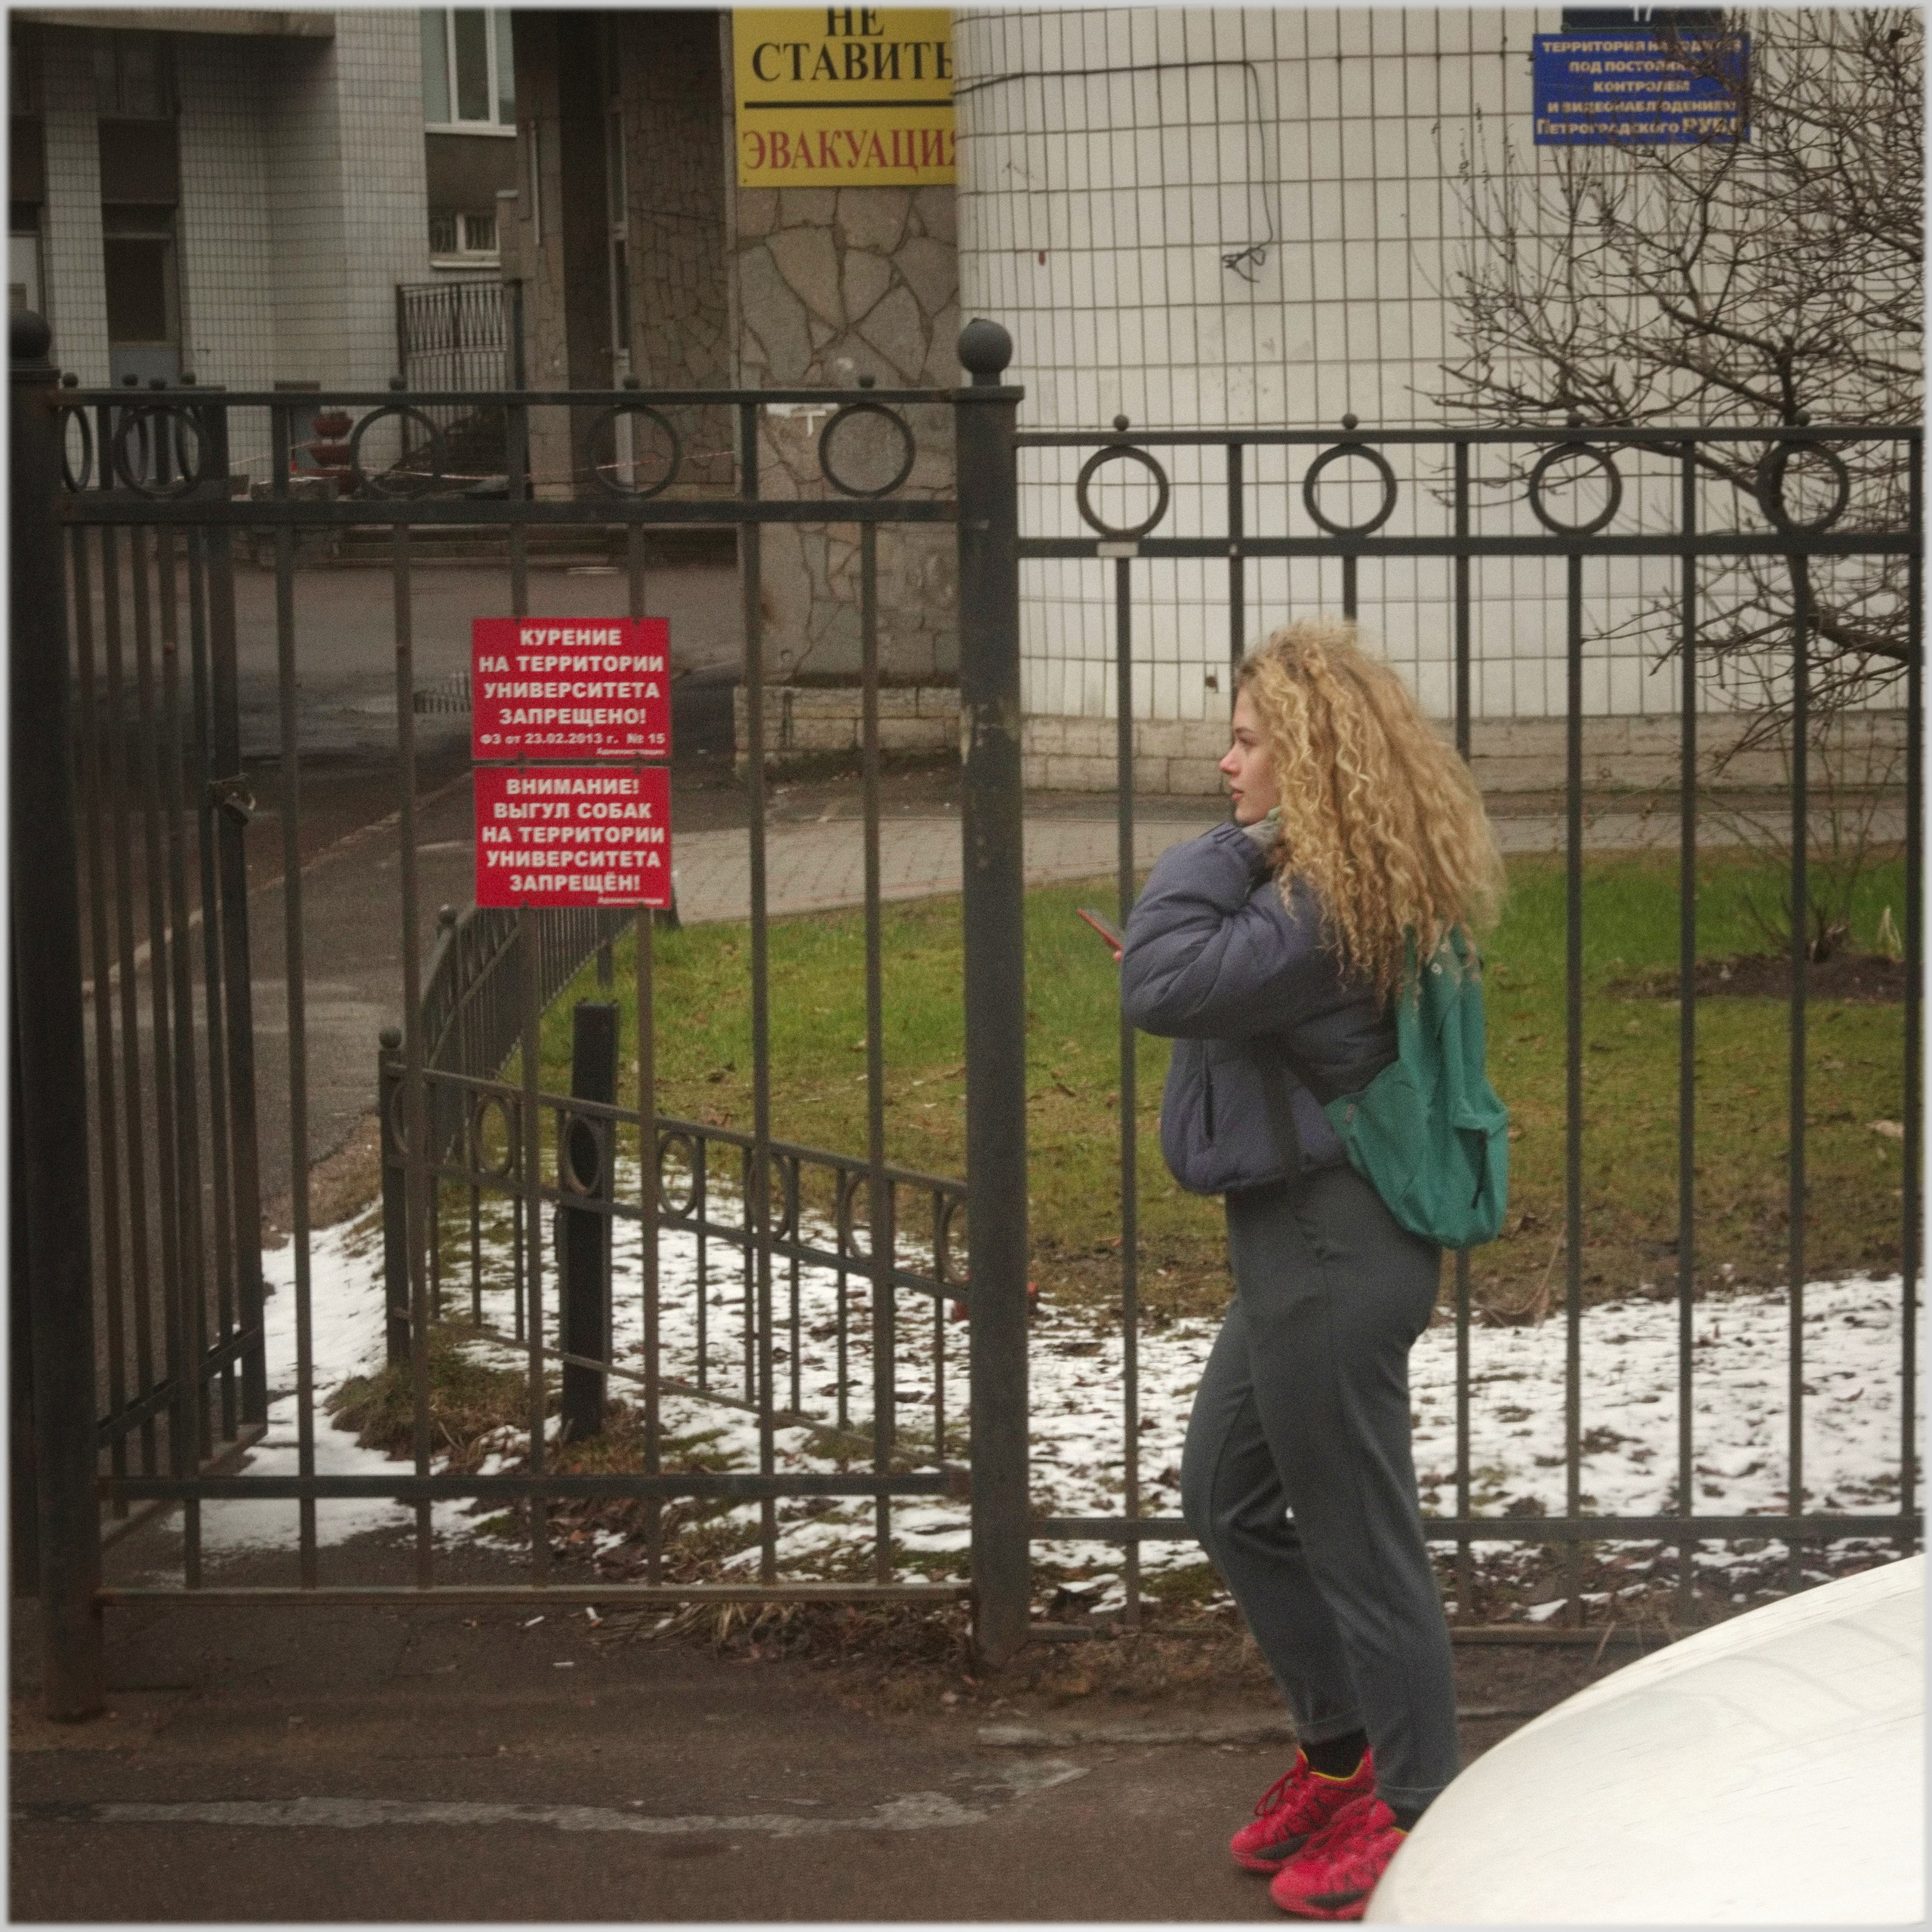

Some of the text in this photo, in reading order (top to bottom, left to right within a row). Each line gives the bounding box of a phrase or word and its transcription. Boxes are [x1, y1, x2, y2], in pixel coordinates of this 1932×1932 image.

[825, 6, 884, 37] НЕ
[1543, 41, 1645, 52] ТЕРРИТОРИЯ
[1569, 61, 1602, 74] ПОД
[1593, 80, 1691, 93] КОНТРОЛЕМ
[1548, 103, 1559, 113] И
[520, 629, 622, 646] КУРЕНИЕ
[478, 655, 664, 672] НА ТЕРРИТОРИИ
[484, 682, 660, 699] УНИВЕРСИТЕТА
[499, 708, 647, 728] ЗАПРЕЩЕНО!
[505, 736, 521, 744] от
[525, 733, 603, 745] 23.02.2013
[649, 733, 666, 744] 15
[506, 778, 641, 795] ВНИМАНИЕ!
[494, 802, 653, 820] ВЫГУЛ СОБАК
[481, 826, 665, 844] НА ТЕРРИТОРИИ
[486, 851, 662, 868] УНИВЕРСИТЕТА
[509, 871, 641, 894] ЗАПРЕЩЁН!
